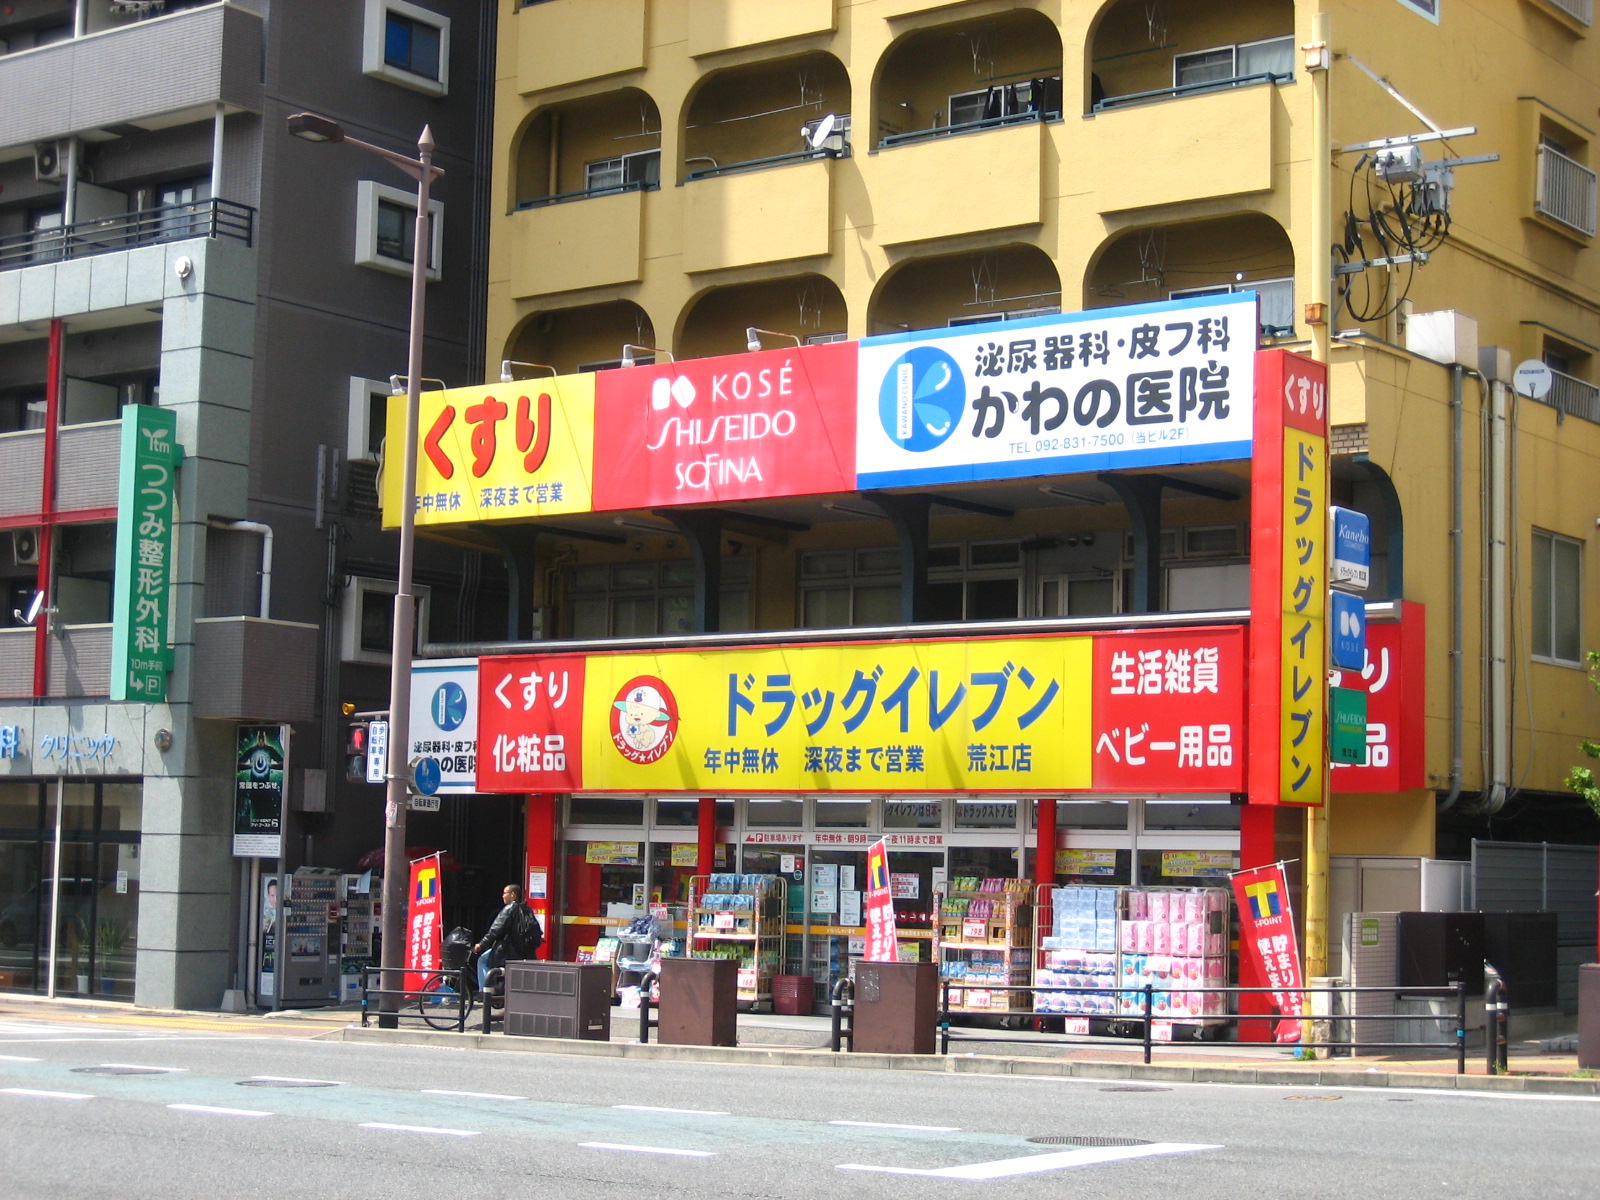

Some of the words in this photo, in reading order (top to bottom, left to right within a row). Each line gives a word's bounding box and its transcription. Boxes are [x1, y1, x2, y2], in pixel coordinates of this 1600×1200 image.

[971, 361, 1231, 438] かわの医院
[1284, 373, 1324, 420] くすり
[423, 393, 551, 479] くすり
[646, 410, 797, 449] SHISEIDO
[1009, 442, 1031, 454] TEL
[1035, 433, 1125, 452] 092-831-7500
[674, 454, 762, 490] SOFINA
[479, 482, 563, 508] 深夜まで営業
[134, 464, 168, 653] つつみ整形外科
[1290, 441, 1315, 792] ドラッグイレブン
[495, 671, 568, 711] くすり
[1110, 646, 1219, 695] 生活雑貨
[727, 660, 1060, 737] ドラッグイレブン
[40, 733, 115, 759] クリニック
[492, 733, 566, 773] 化粧品
[703, 748, 780, 774] 年中無休
[804, 745, 925, 773] 深夜まで営業
[966, 743, 1032, 773] 荒江店
[1095, 722, 1233, 768] ベビー用品
